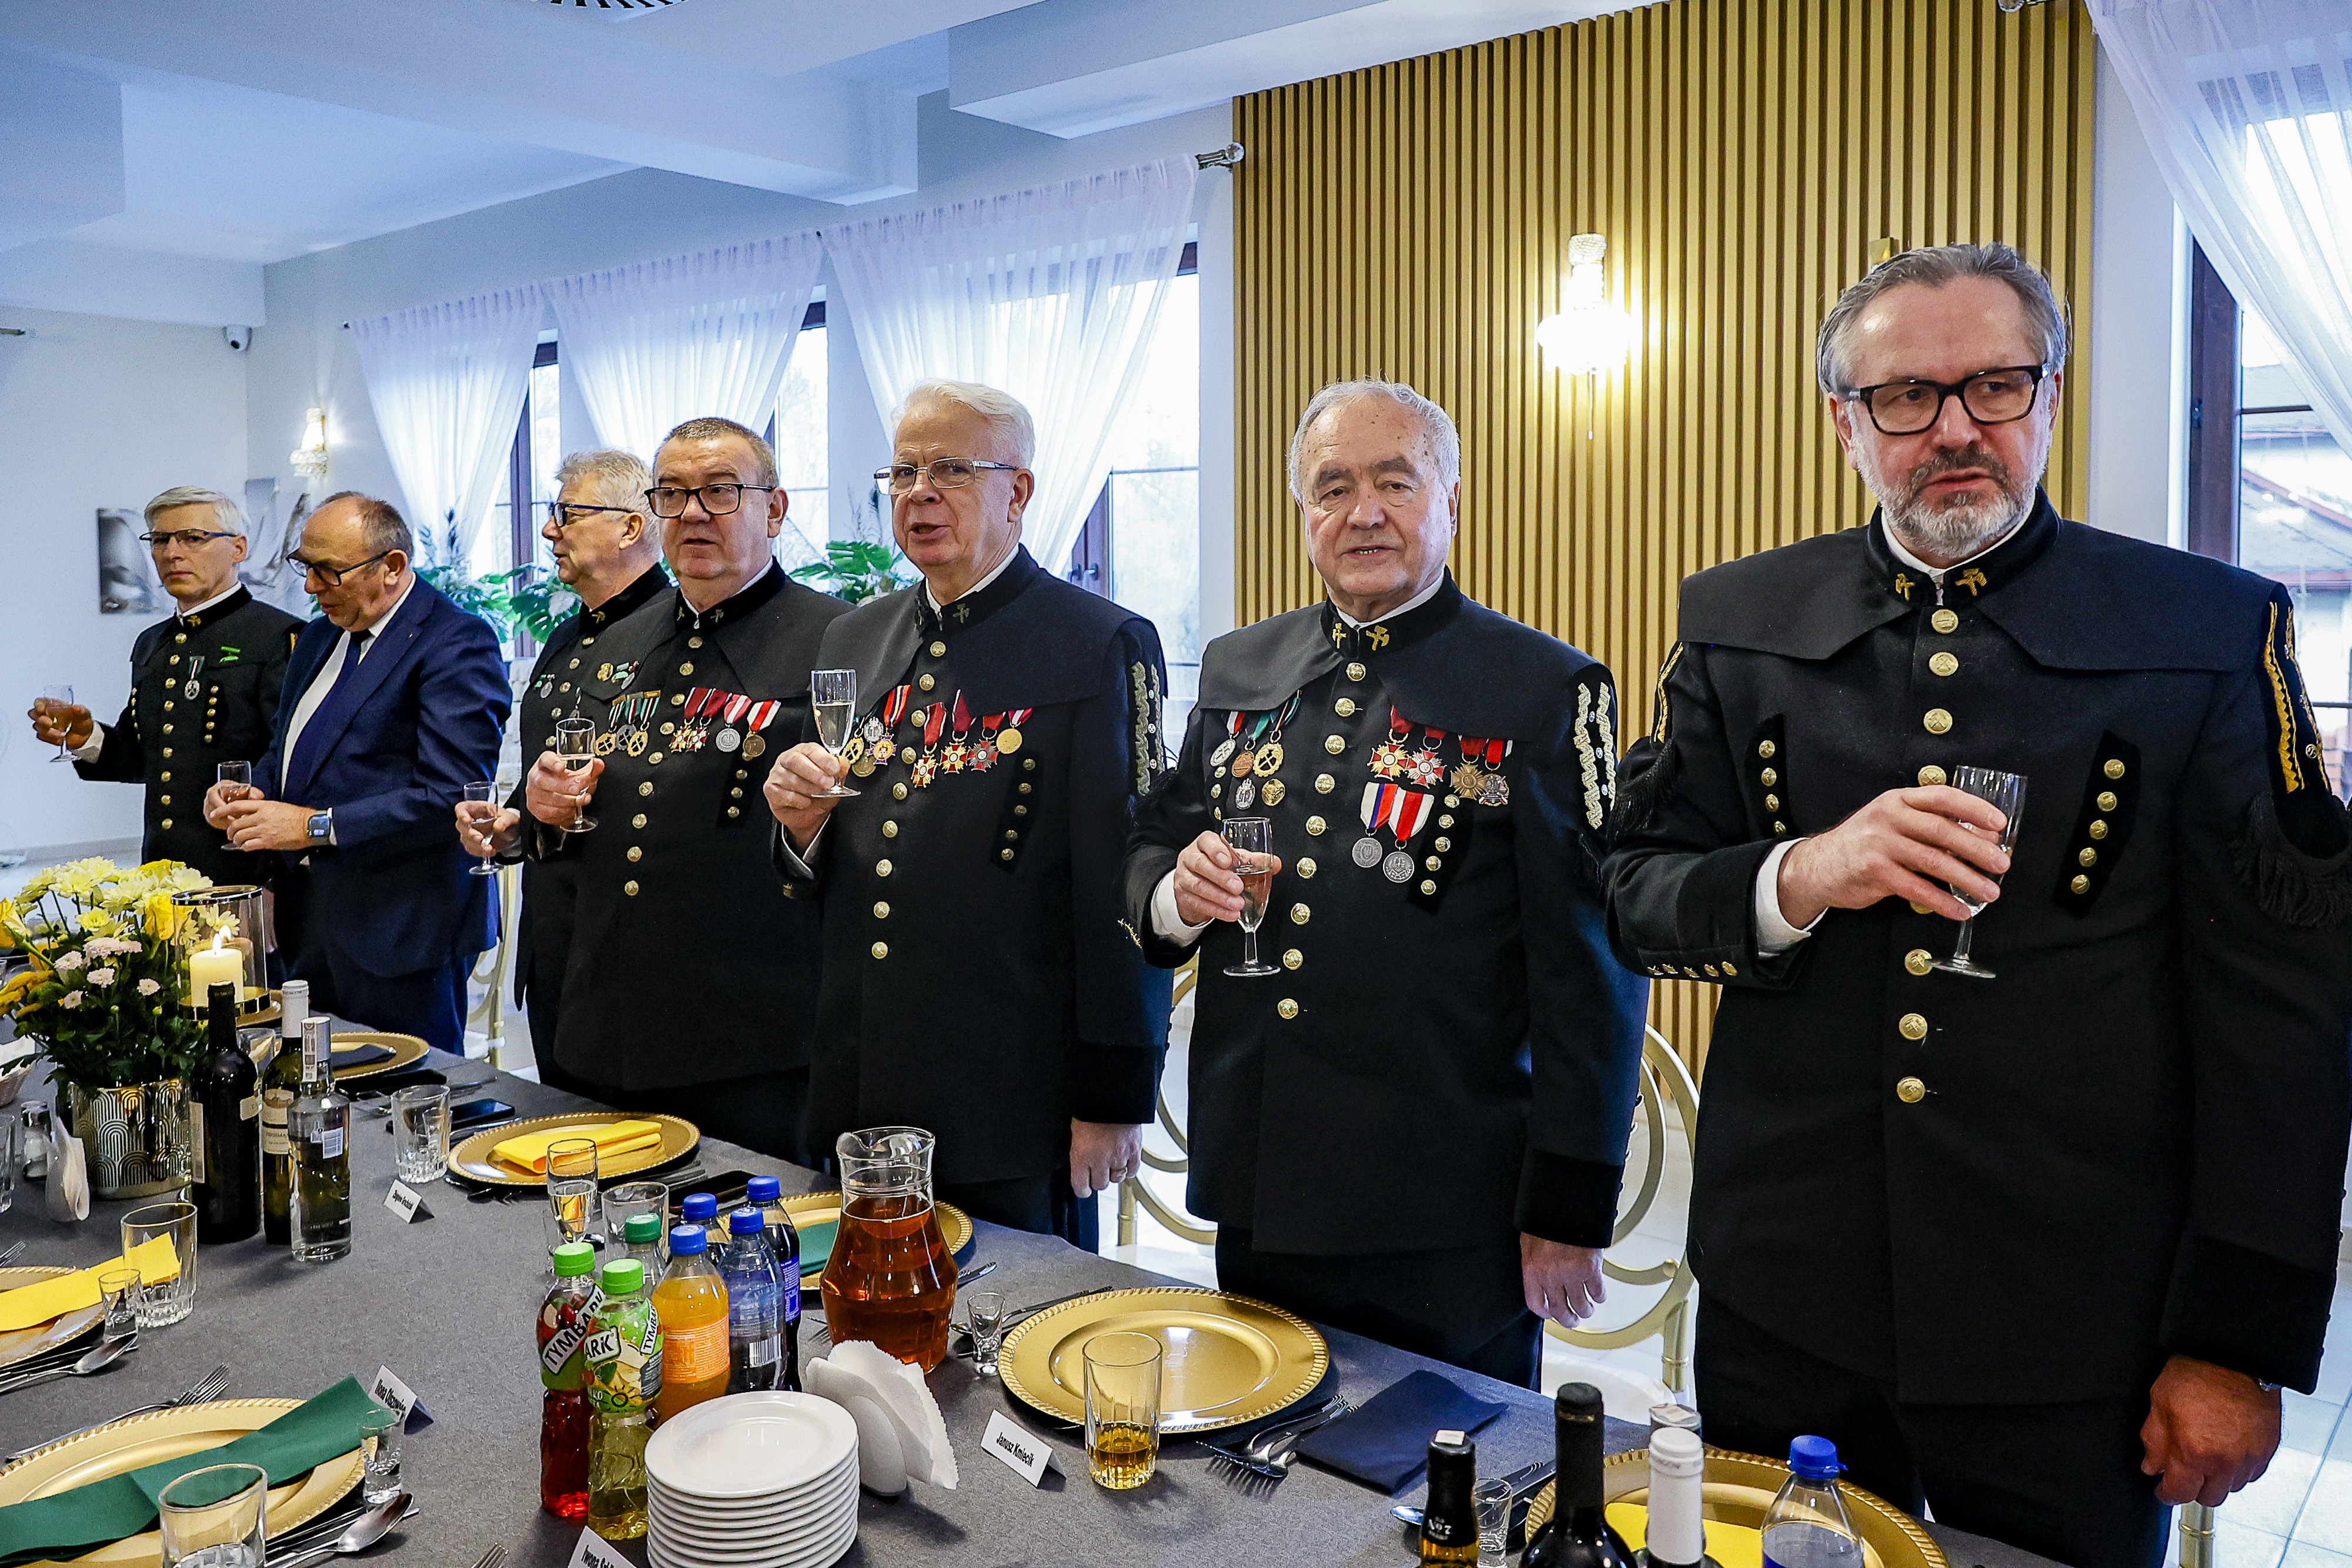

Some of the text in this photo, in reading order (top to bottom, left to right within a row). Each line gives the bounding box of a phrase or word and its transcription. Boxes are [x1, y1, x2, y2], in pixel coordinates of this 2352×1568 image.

[996, 1432, 1034, 1467] Janusz Kmiecik
[581, 1544, 599, 1568] Iwona
